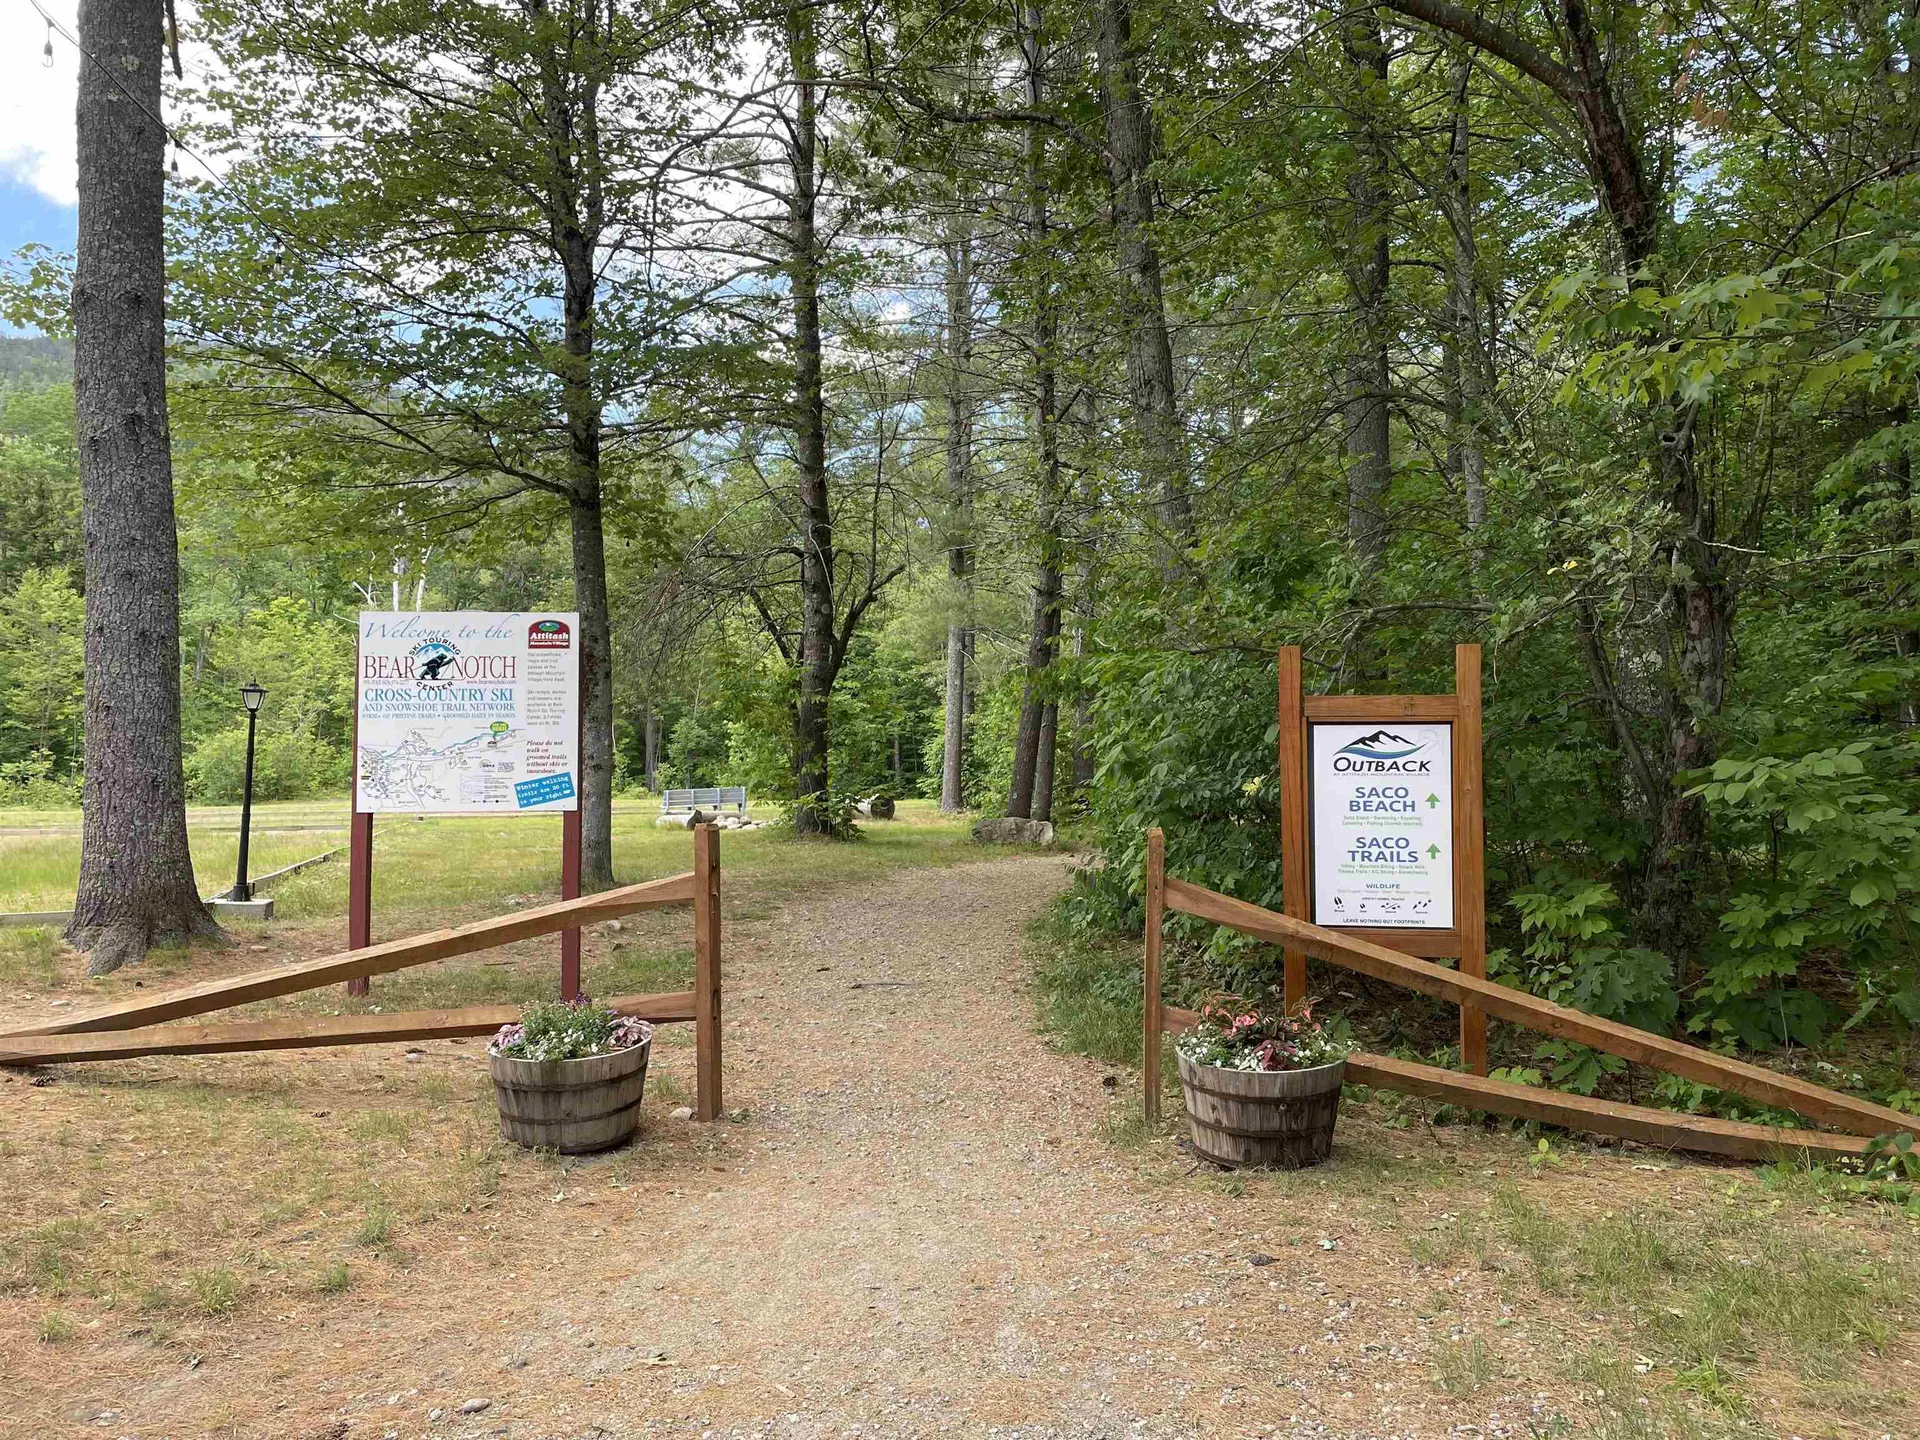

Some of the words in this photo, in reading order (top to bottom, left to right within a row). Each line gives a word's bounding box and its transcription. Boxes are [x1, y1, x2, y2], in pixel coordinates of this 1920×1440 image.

[365, 616, 450, 638] Welcome
[459, 626, 476, 638] to
[485, 614, 520, 638] the
[530, 632, 569, 640] Attitash
[409, 643, 421, 655] SKI
[423, 637, 461, 655] TOURING
[363, 656, 416, 678] BEAR
[452, 656, 517, 678] NOTCH
[416, 681, 454, 691] CENTER
[365, 688, 488, 702] CROSS-COUNTRY
[491, 688, 513, 701] SKI
[363, 703, 382, 712] AND
[385, 703, 438, 712] SNOWSHOE
[441, 703, 467, 712] TRAIL
[470, 703, 515, 711] NETWORK
[516, 782, 539, 790] Winter
[542, 776, 569, 785] walking
[1355, 786, 1409, 799] SACO
[530, 796, 543, 804] your
[1349, 800, 1415, 812] BEACH
[1356, 837, 1410, 849] SACO
[1347, 850, 1419, 862] TRAILS
